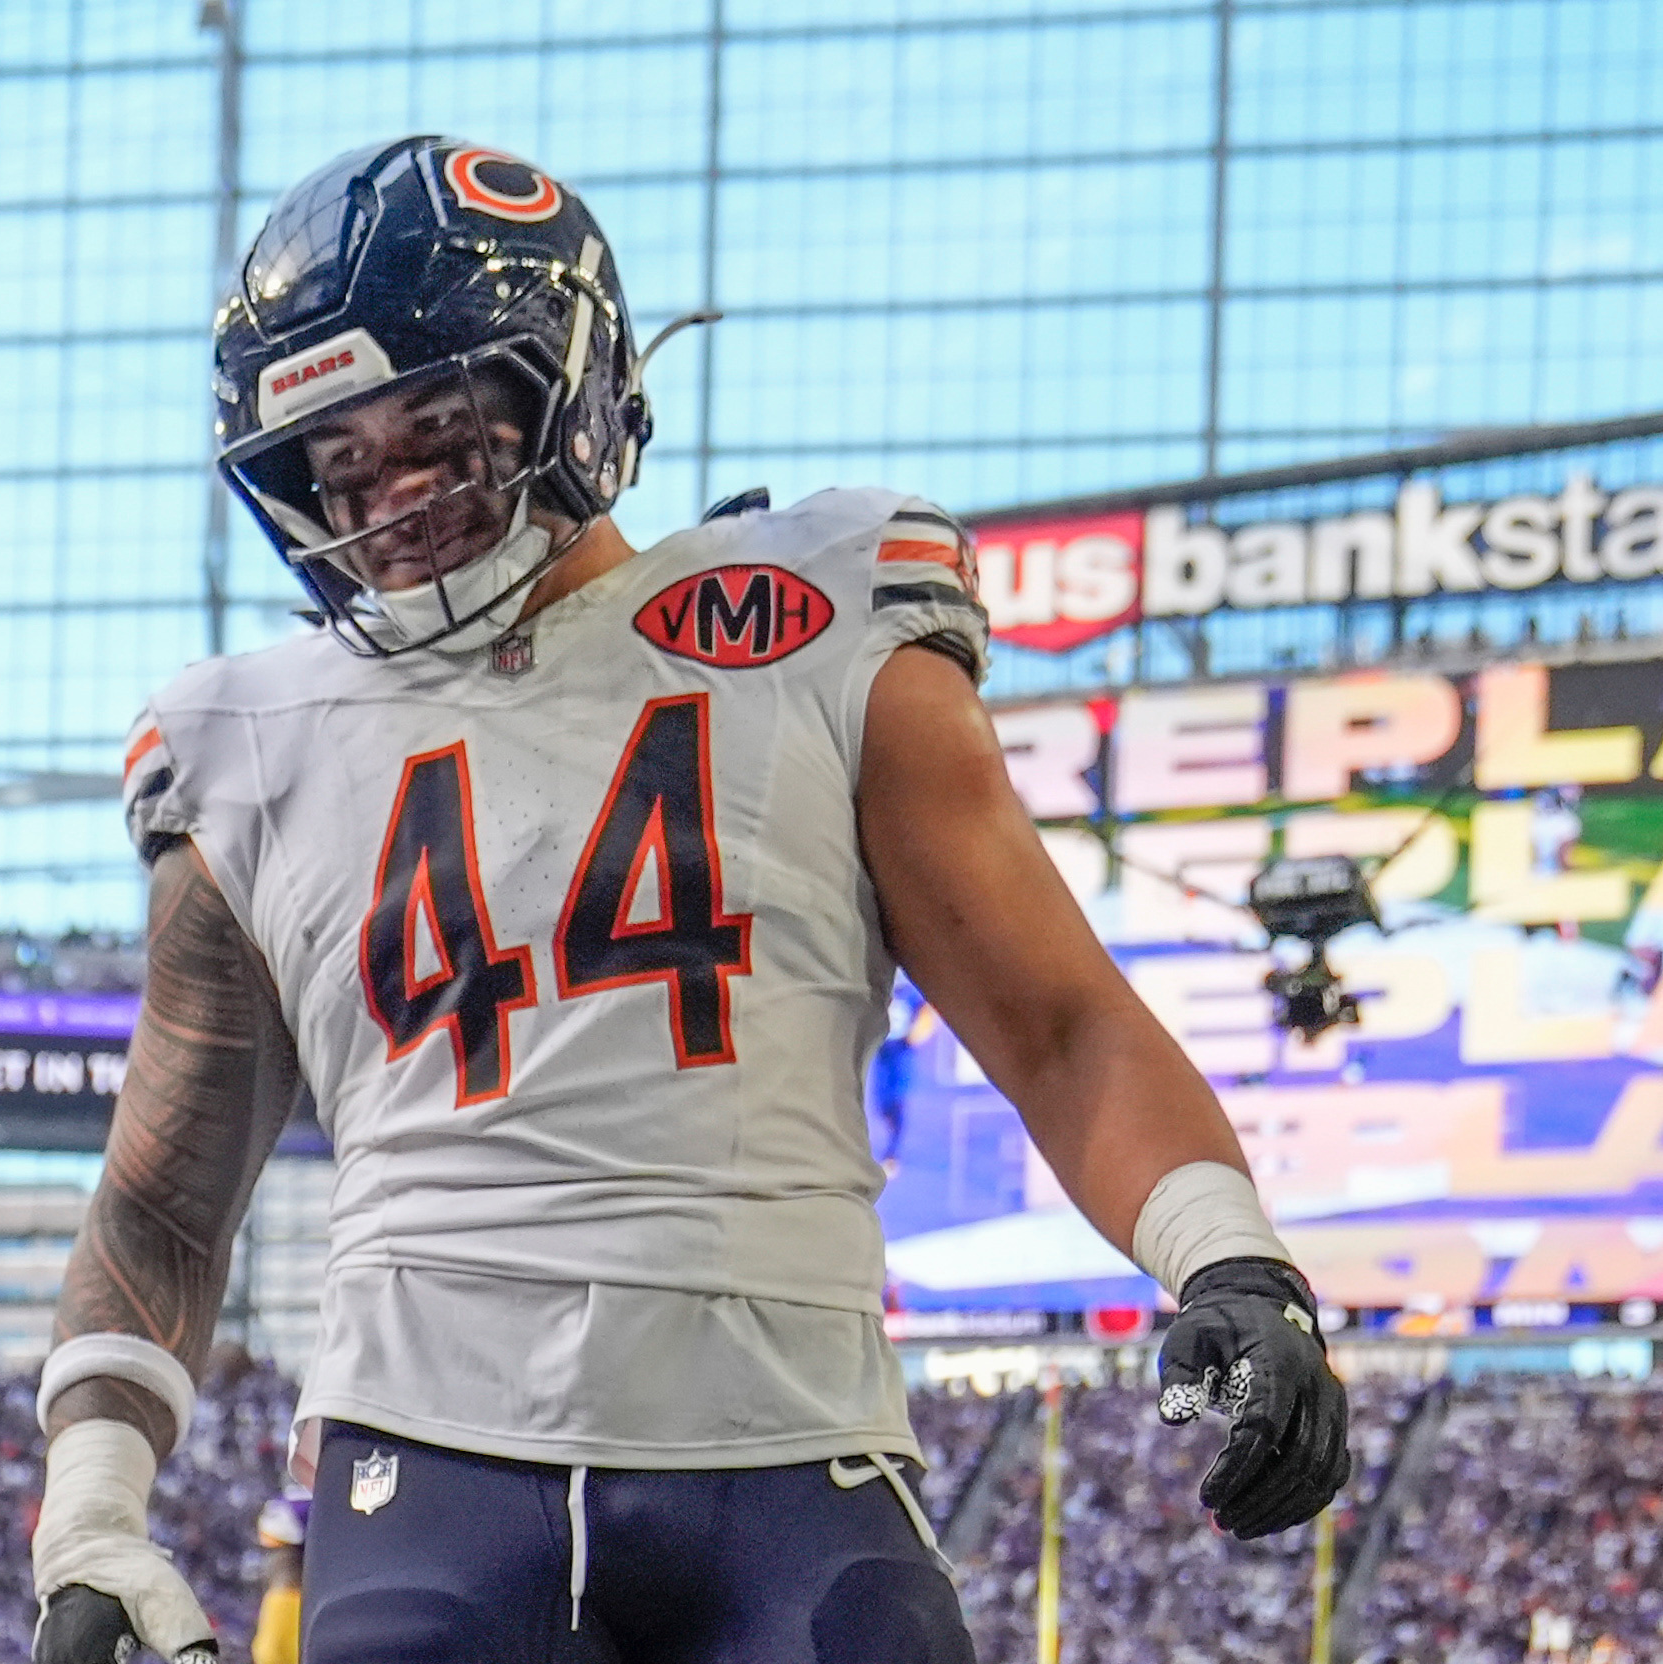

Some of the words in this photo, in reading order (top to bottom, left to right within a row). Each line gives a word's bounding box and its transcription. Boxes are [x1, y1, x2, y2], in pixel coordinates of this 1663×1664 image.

[271, 349, 355, 396] BEARS
[360, 692, 752, 1109] 44
[34, 1051, 84, 1094] IN
